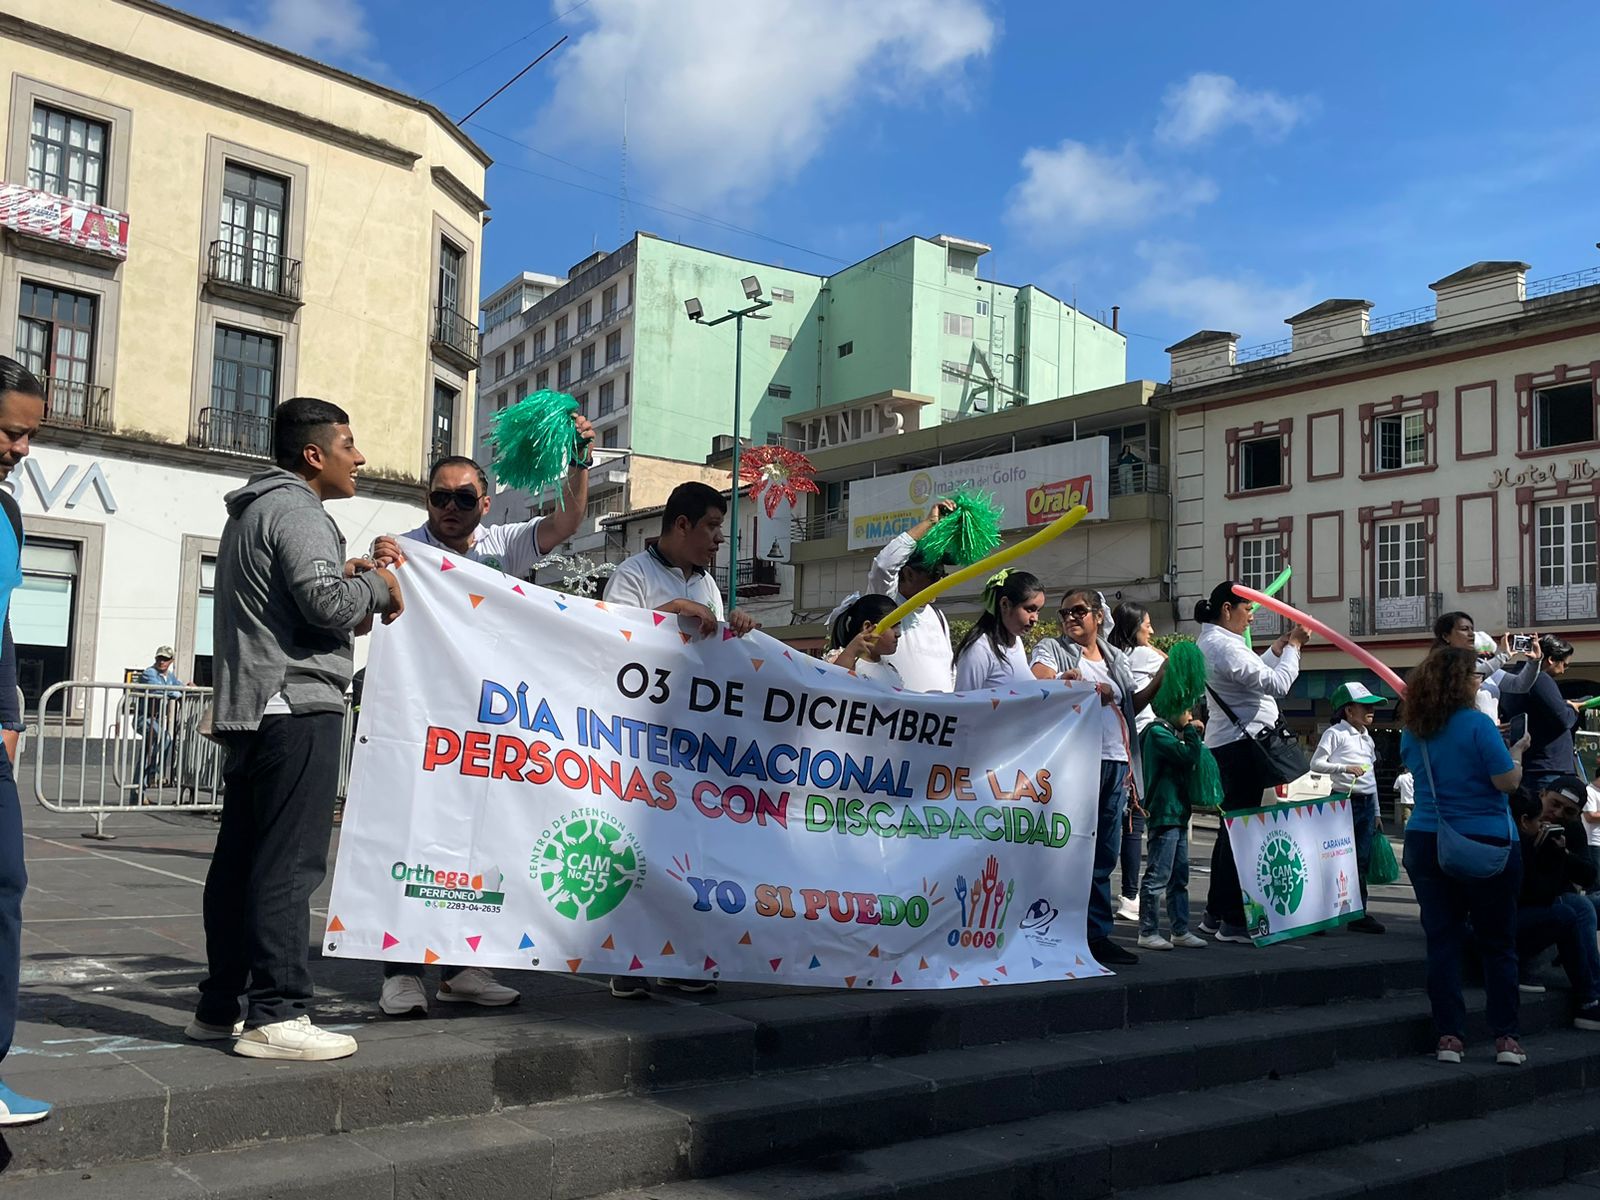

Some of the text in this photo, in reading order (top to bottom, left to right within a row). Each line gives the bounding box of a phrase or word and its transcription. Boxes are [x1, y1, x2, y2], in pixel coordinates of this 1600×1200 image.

[993, 466, 1026, 484] Golfo
[1488, 463, 1557, 489] Hotel
[689, 677, 744, 717] DE
[763, 688, 958, 747] DICIEMBRE
[477, 679, 1052, 804] DÍA INTERNACIONAL DE LAS
[423, 726, 1072, 848] PERSONAS CON DISCAPACIDAD
[529, 807, 647, 890] CENTRO DE ATENCION MULTIPLE
[1322, 837, 1351, 850] CARAVANA
[566, 853, 611, 873] CAM
[1271, 864, 1293, 879] CAM
[391, 861, 469, 889] Orthega
[581, 871, 610, 893] 55
[1281, 876, 1294, 893] 55
[420, 887, 476, 901] PERIFONEO
[687, 876, 929, 928] YO SI PUEDO
[446, 902, 501, 913] 2283-04-2635
